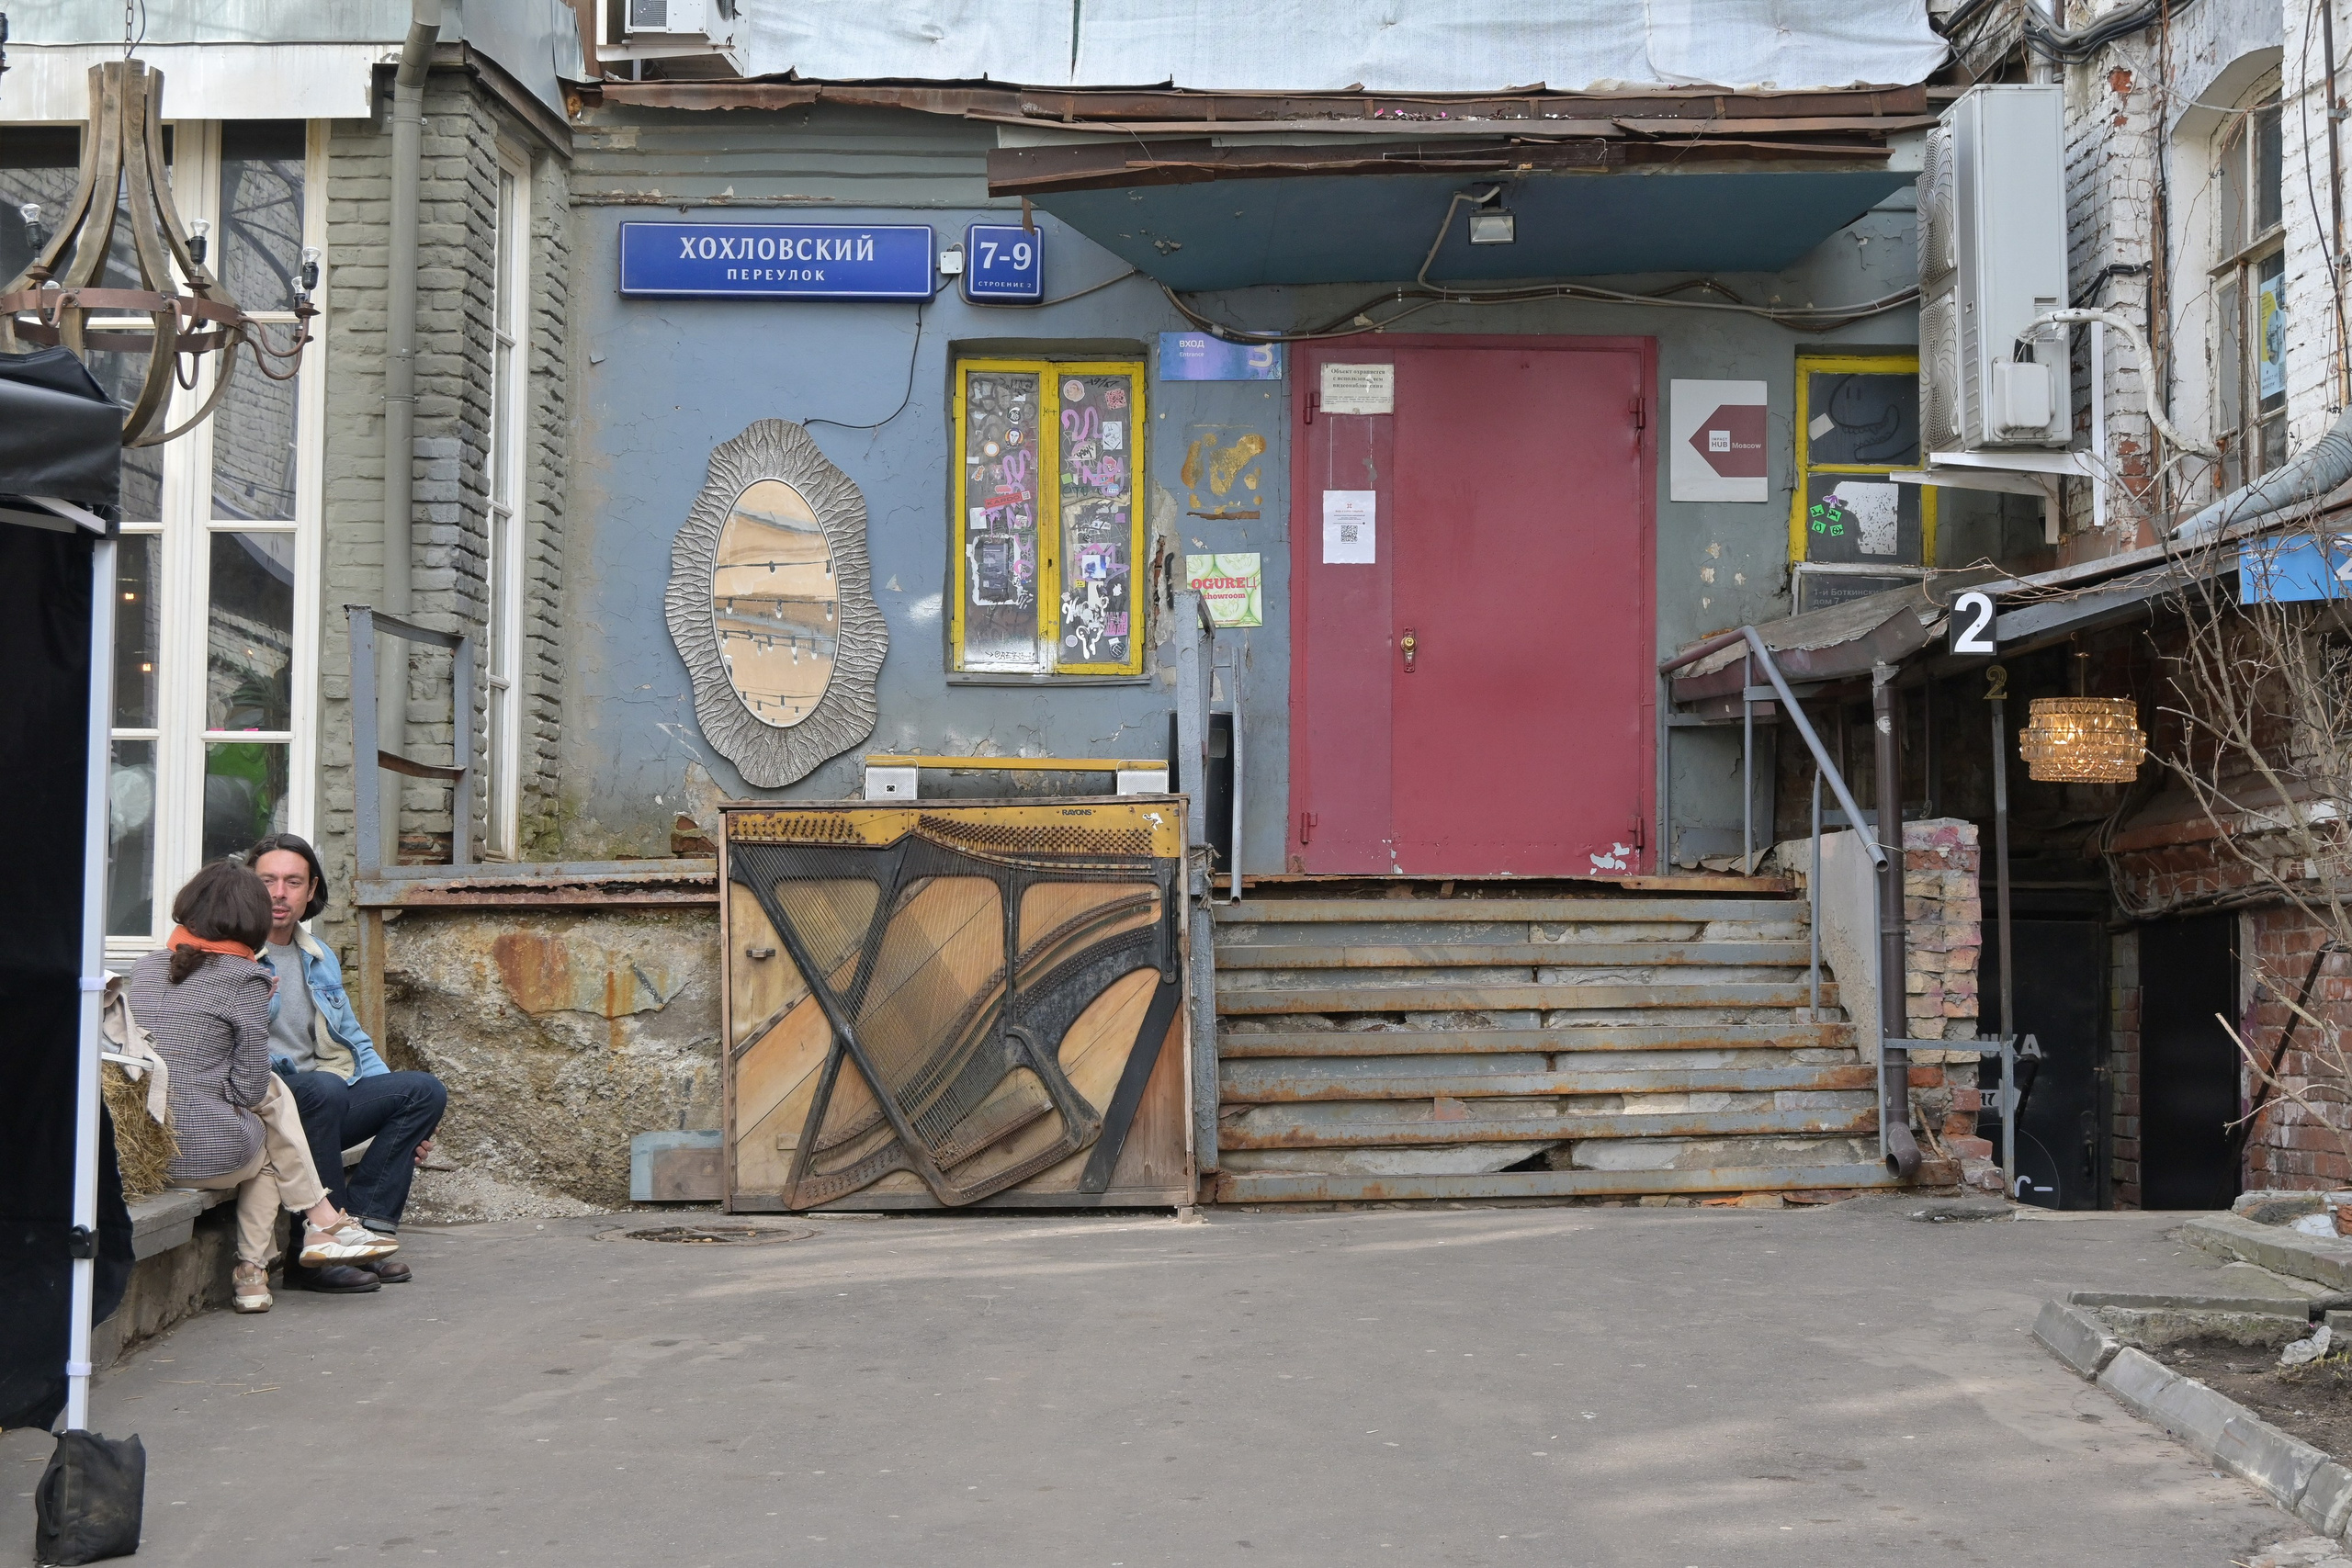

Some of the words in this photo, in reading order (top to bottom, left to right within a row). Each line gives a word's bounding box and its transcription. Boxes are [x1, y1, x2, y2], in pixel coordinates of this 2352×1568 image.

[679, 234, 874, 261] ХОХЛОВСКИЙ
[979, 242, 1032, 270] 7-9
[727, 268, 825, 281] ПЕРЕУЛОК
[1179, 340, 1205, 348] ВХОД
[1831, 588, 1884, 596] Боткински
[1954, 592, 1994, 652] 2
[1983, 664, 2007, 700] 2
